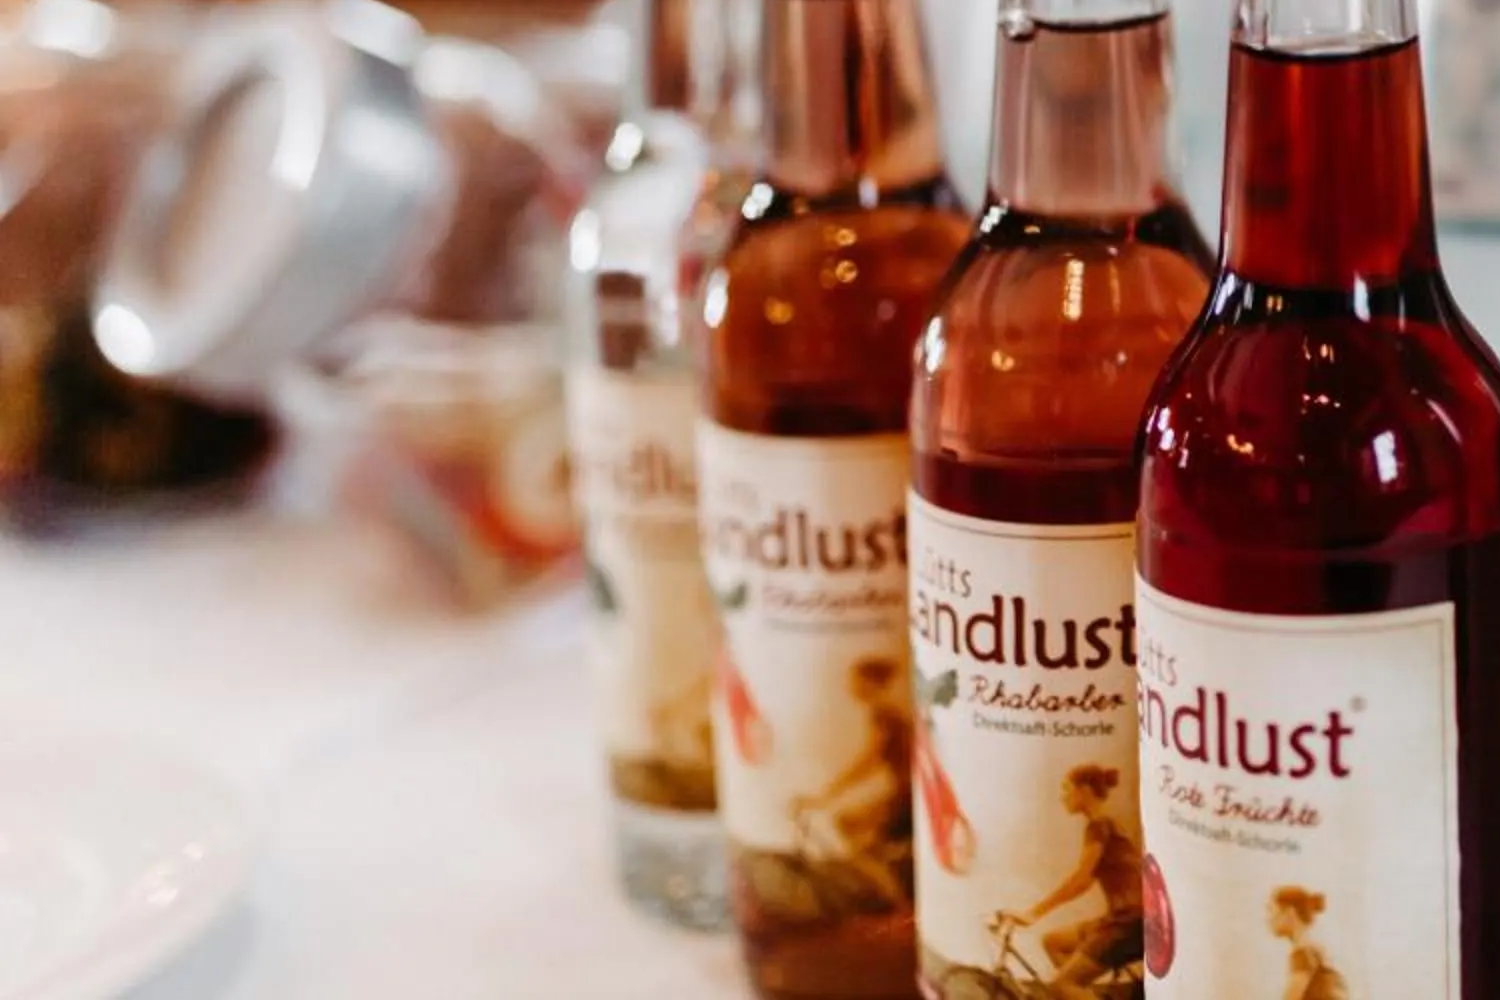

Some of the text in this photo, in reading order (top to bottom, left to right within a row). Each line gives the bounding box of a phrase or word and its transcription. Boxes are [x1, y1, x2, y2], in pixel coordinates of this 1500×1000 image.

[911, 588, 1138, 671] andlust
[969, 674, 1125, 713] Rhabarber
[1138, 685, 1354, 779] ndlust
